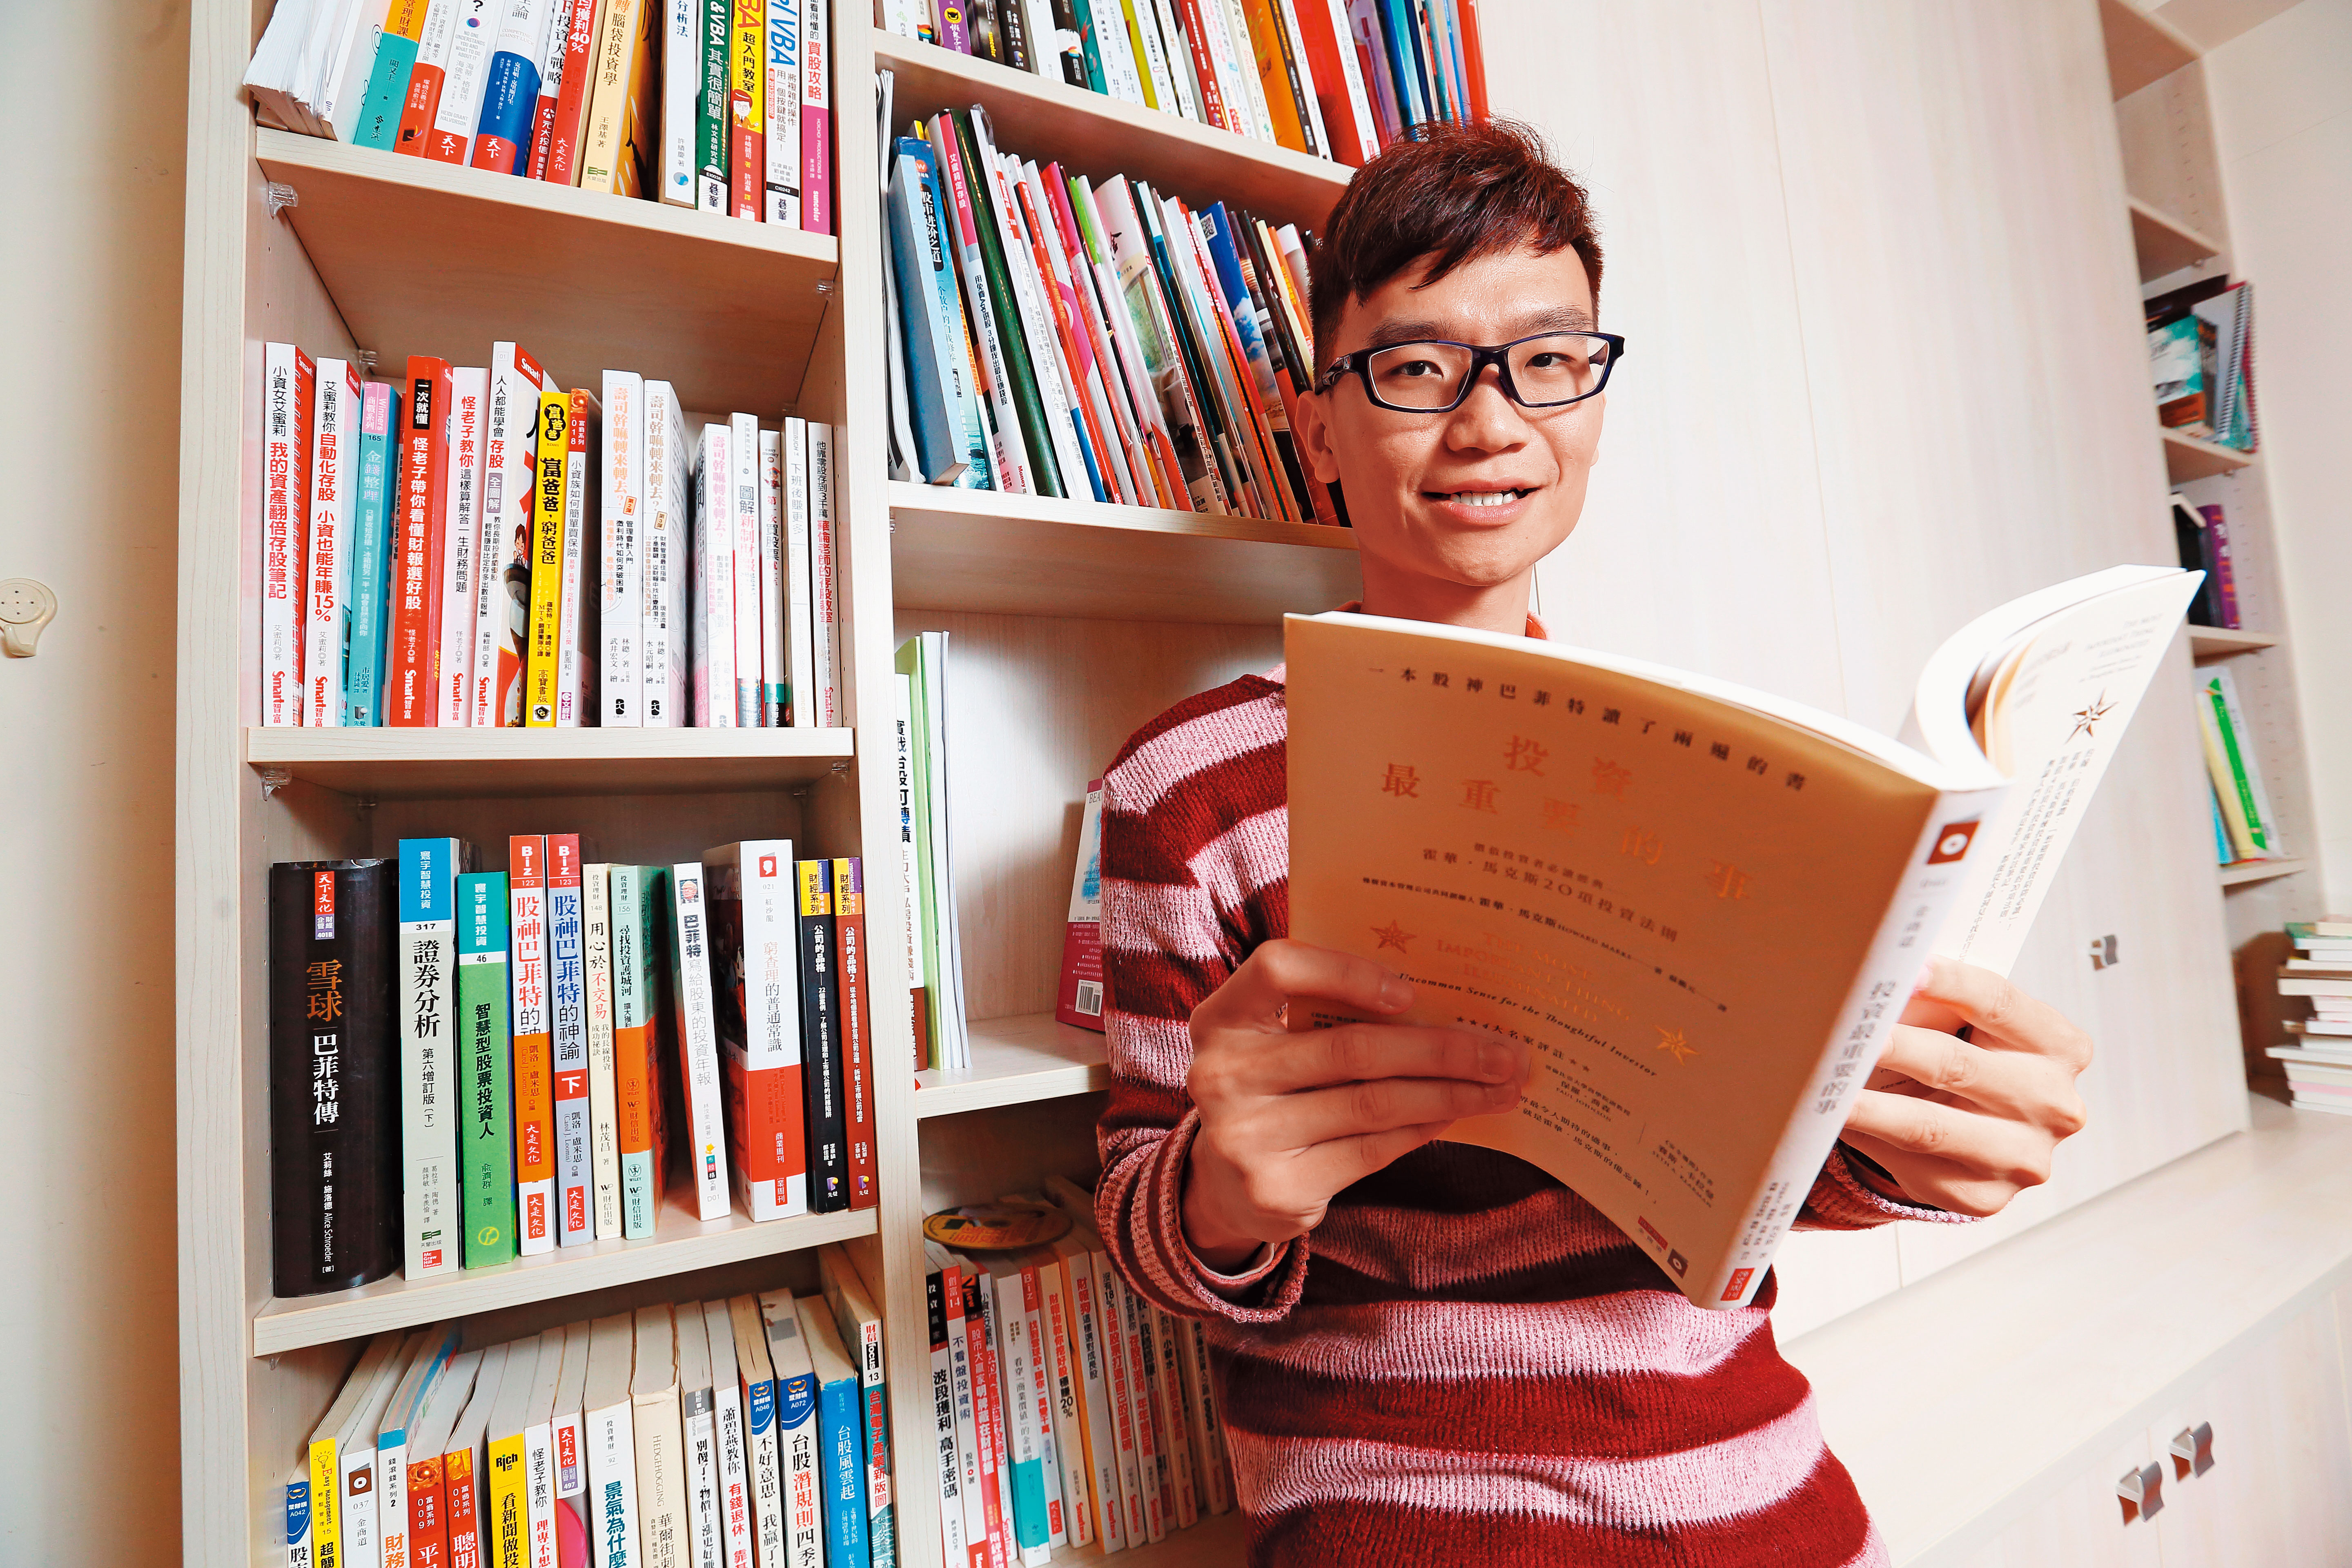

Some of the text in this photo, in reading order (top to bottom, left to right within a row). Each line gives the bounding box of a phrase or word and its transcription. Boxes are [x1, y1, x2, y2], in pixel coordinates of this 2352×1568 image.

[502, 28, 532, 40] COMPETING
[676, 0, 688, 38] 分析法
[455, 34, 485, 46] UNDERSTANDS
[519, 37, 535, 47] LUCK
[771, 18, 796, 66] VBA
[743, 32, 755, 93] 超入門教室
[807, 41, 822, 100] 買股攻略
[707, 47, 723, 120] 其實很簡單
[787, 73, 797, 127] 將複雜的操作
[440, 116, 467, 126] HALVORSON
[441, 109, 469, 122] HEIDI GRANT
[597, 116, 609, 139] 王澤基
[555, 138, 569, 171] 大是文化
[710, 123, 719, 165] 林文恭研究室
[949, 153, 966, 208] 艾蜜莉定存股
[298, 356, 312, 377] Smart
[365, 396, 376, 430] 商戰系列
[376, 398, 387, 431] Winners
[415, 383, 429, 425] 一次就懂
[268, 366, 288, 599] 小資女艾蜜莉 我的資產翻倍存股筆記
[362, 450, 382, 502] 金錢整理
[487, 477, 501, 510] 全圖解
[567, 460, 582, 558] 小資族如何簡單買保險
[625, 498, 635, 514] 第2彈
[791, 463, 804, 535] 下班後賺更多
[405, 437, 429, 611] 怪老子帶你看懂財報選好股
[656, 514, 665, 529] 第3彈
[314, 510, 335, 622] 小資也能年賺15%
[564, 650, 572, 670] 劉鳳和
[536, 669, 548, 703] 高寶書版
[561, 702, 571, 720] 文經社
[420, 851, 431, 909] 寰宇智慧投資
[521, 845, 533, 876] Biz
[318, 873, 332, 913] 天下文化
[765, 898, 774, 922] 紅沙龍
[808, 874, 819, 914] 財經系列
[474, 883, 488, 947] 寰宇智慧投資
[477, 954, 487, 963] 46
[588, 922, 609, 1020] 用心於不交易
[619, 924, 632, 996] 尋找投資護城河
[306, 959, 343, 1022] 雪球
[412, 939, 441, 1039] 證券分析
[555, 896, 581, 1061] 股神巴菲特的神諭
[763, 941, 783, 1053] 窮查理的普通常識
[1399, 973, 1462, 991] Uncommon
[1466, 987, 1497, 1000] Sense
[1499, 997, 1518, 1007] for
[1522, 1006, 1540, 1016] the
[684, 914, 712, 1086] 巴菲特寫給股東的投資年報
[601, 1024, 611, 1071] 我的長線投資
[313, 1033, 339, 1125] 巴菲特傳
[474, 1003, 494, 1140] 智慧型股票投資人
[526, 1125, 540, 1163] 大是文化
[599, 1122, 611, 1152] 林茂昌
[775, 1132, 784, 1163] 商業周刊
[481, 1163, 492, 1189] 俞濟群
[324, 1212, 332, 1229] Alice
[869, 1372, 880, 1381] 13
[952, 1336, 971, 1420] 不看盤投資術
[755, 1404, 770, 1412] A046
[791, 1401, 806, 1410] A072
[561, 1429, 575, 1466] 天下文化
[606, 1420, 615, 1451] 投資理財
[722, 1406, 741, 1476] 蕭碧燕教你
[869, 1390, 886, 1508] 台灣電子產業新版圖
[933, 1369, 958, 1499] 波段獲利 高手密碼
[496, 1452, 518, 1472] Rich
[653, 1434, 665, 1507] HEDGEHOGGING
[837, 1425, 855, 1500] 台股風雲起
[353, 1500, 369, 1510] 037
[425, 1496, 434, 1527] 富翁系列
[452, 1488, 461, 1518] 004
[356, 1518, 368, 1547] 金商道
